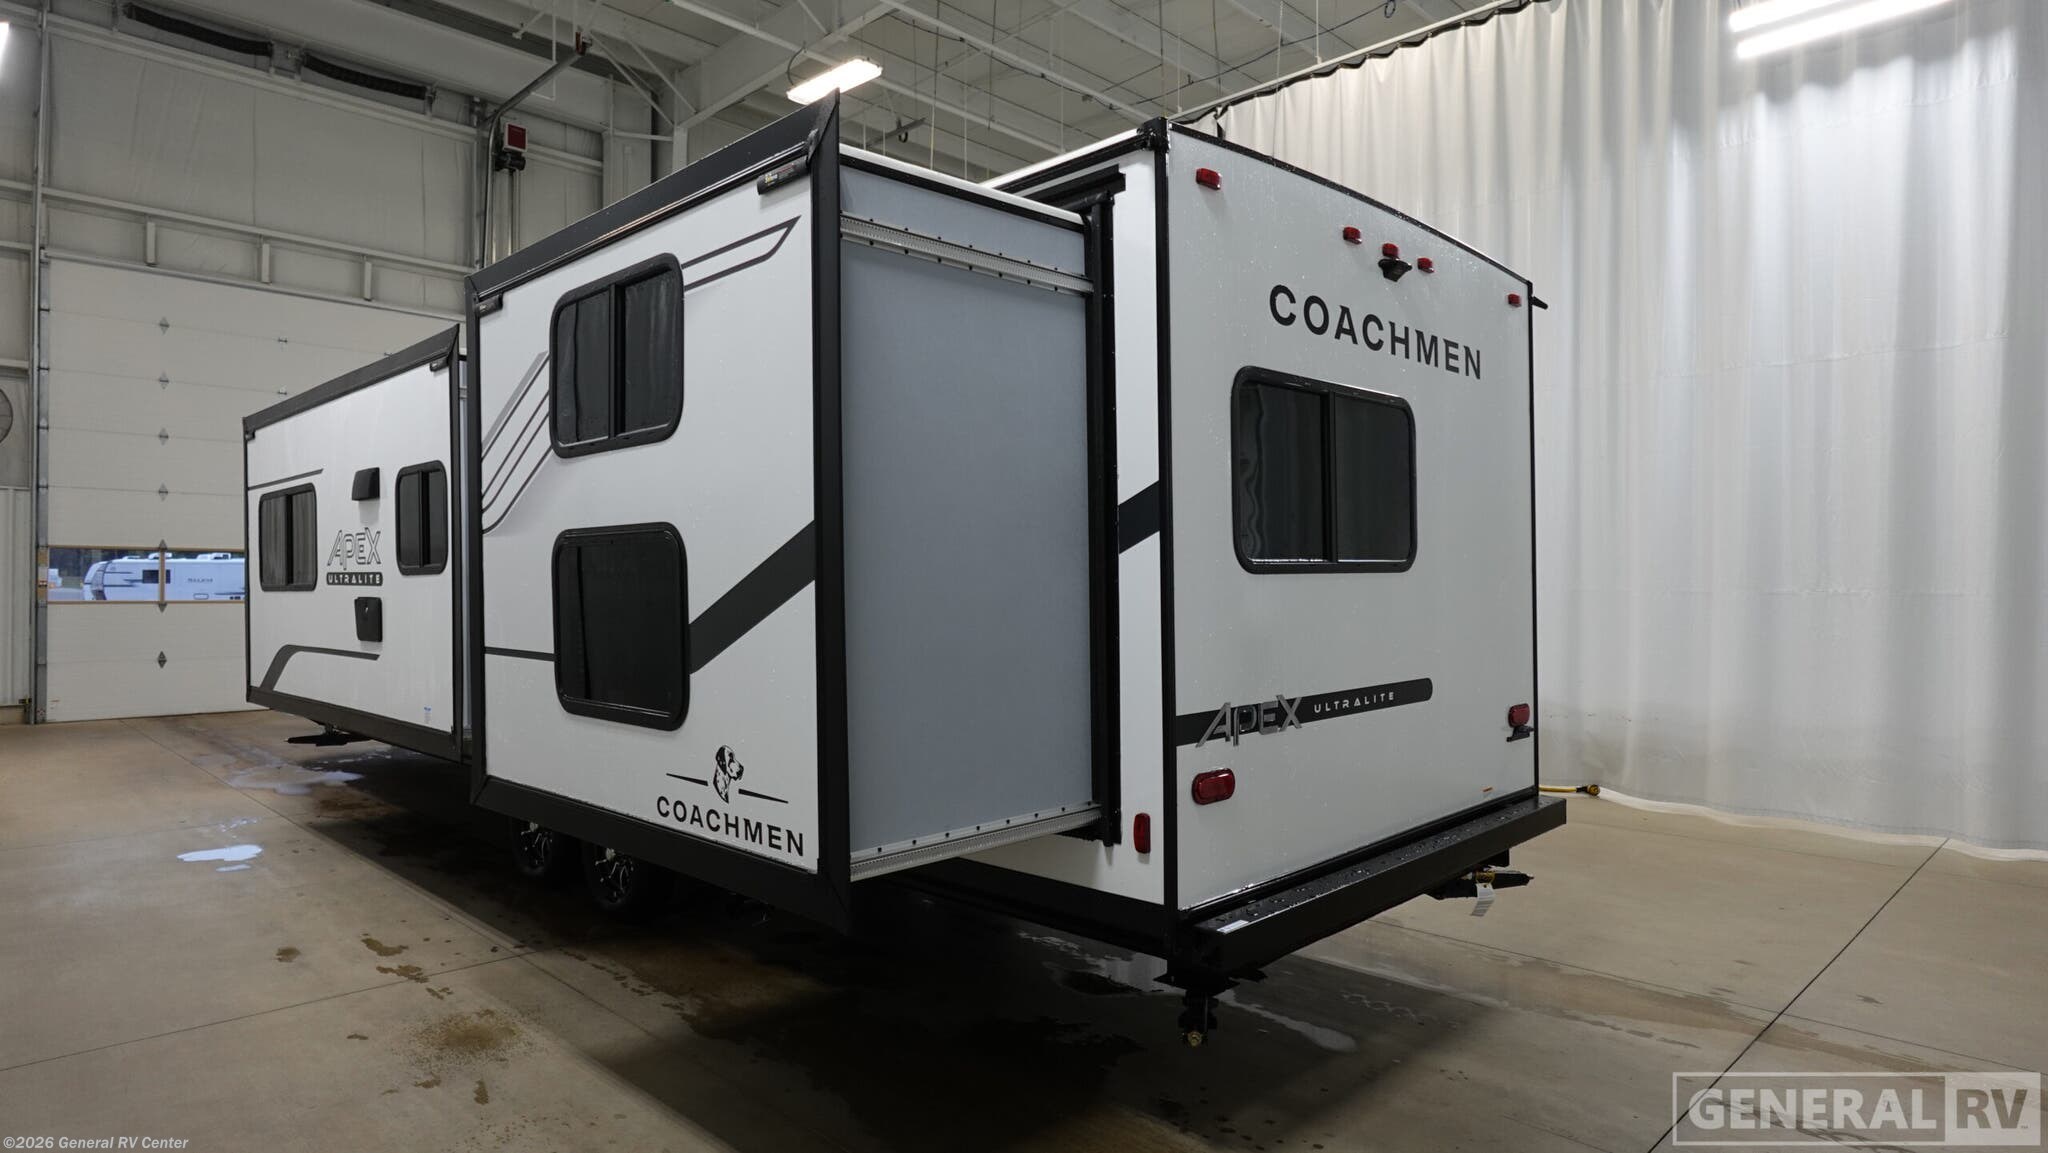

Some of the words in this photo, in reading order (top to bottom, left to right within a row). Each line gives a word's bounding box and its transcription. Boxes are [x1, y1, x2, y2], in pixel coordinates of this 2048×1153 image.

[1269, 284, 1481, 379] COACHMEN
[327, 527, 381, 571] APEX
[328, 573, 381, 584] ULTRALITE
[1196, 694, 1302, 748] APEX
[1314, 691, 1395, 713] ULTRALITE
[657, 796, 804, 856] COACHMEN
